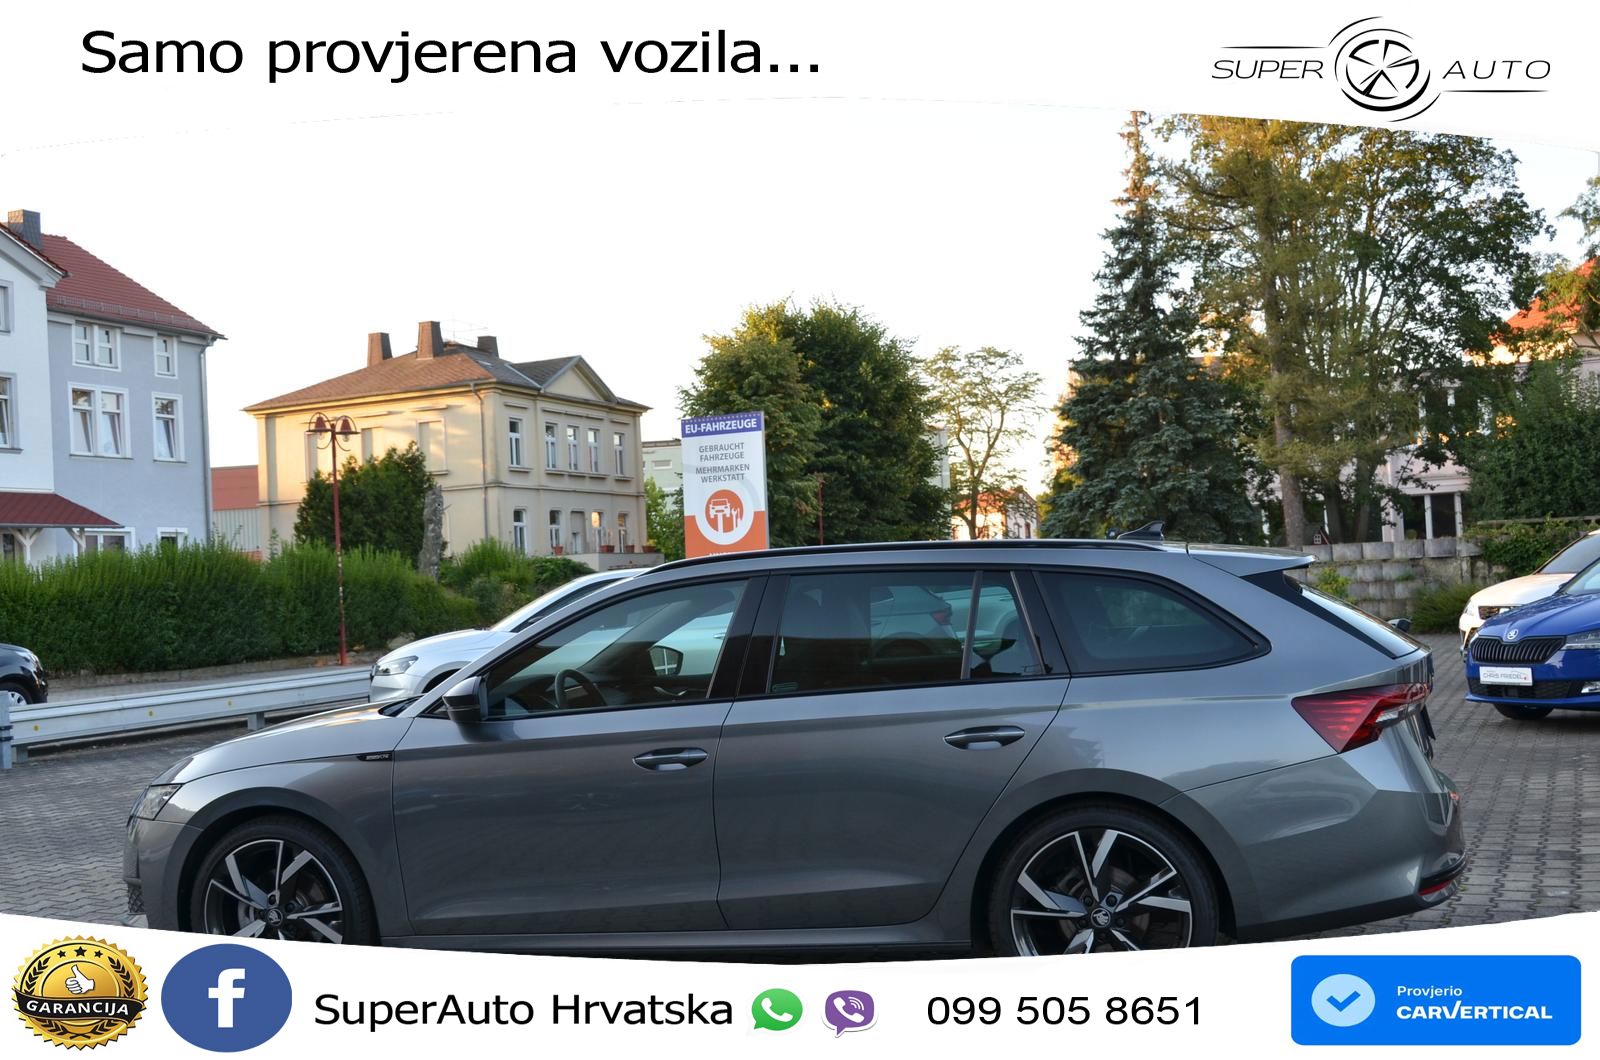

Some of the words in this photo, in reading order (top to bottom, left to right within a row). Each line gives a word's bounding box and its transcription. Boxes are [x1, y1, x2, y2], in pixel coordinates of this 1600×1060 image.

[685, 418, 757, 434] EU-FAHRZEUGE
[698, 442, 745, 453] GEBRAUCHT
[699, 452, 745, 462] FAHRZEUGE
[695, 463, 750, 475] MEHRMARKEN
[700, 473, 745, 483] WERKSTATT
